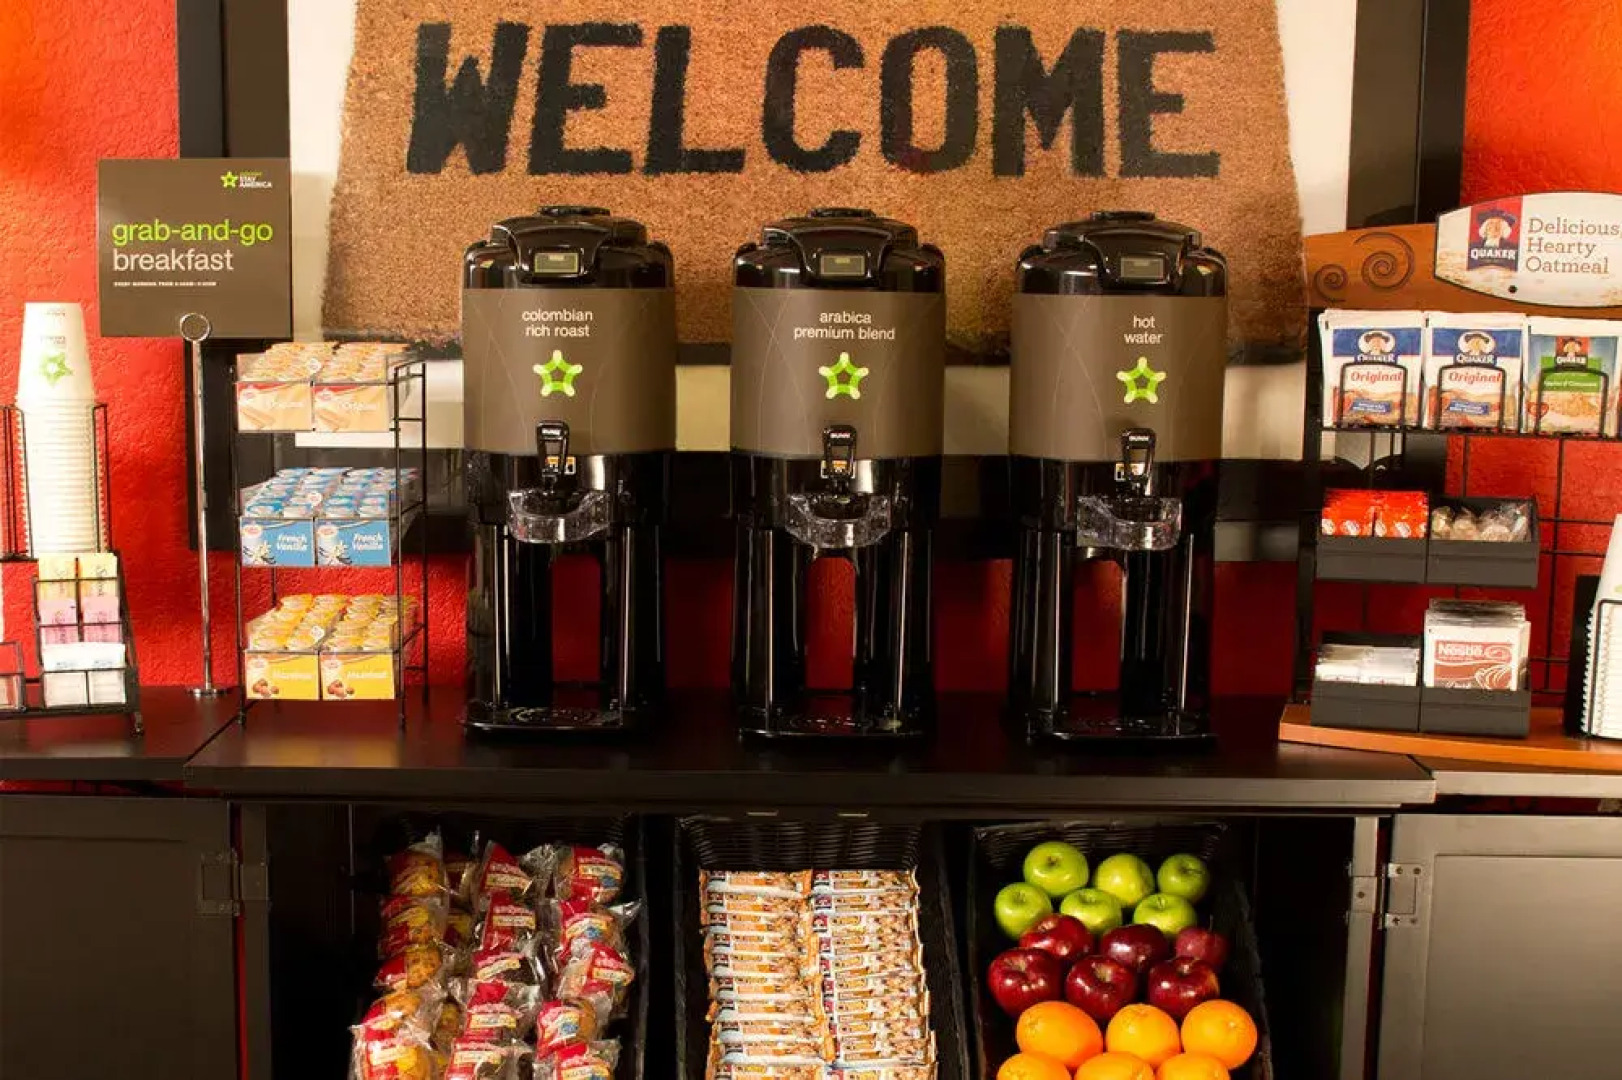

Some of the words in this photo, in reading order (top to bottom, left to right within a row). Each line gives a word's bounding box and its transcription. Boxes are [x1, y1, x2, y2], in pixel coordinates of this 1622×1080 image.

[406, 22, 1222, 178] WELCOME
[112, 218, 273, 246] grab-and-go
[1528, 237, 1596, 257] Hearty
[113, 248, 234, 271] breakfast
[1470, 249, 1517, 260] QUAKER
[1525, 255, 1609, 274] Oatmeal
[522, 308, 593, 322] colombian
[819, 311, 872, 324] arabica
[1133, 315, 1156, 329] hot
[525, 323, 551, 337] rich
[554, 324, 590, 338] roast
[794, 326, 854, 341] premium
[858, 326, 896, 340] blend
[1123, 331, 1163, 345] water
[1350, 371, 1402, 384] Original
[1449, 371, 1502, 385] Original
